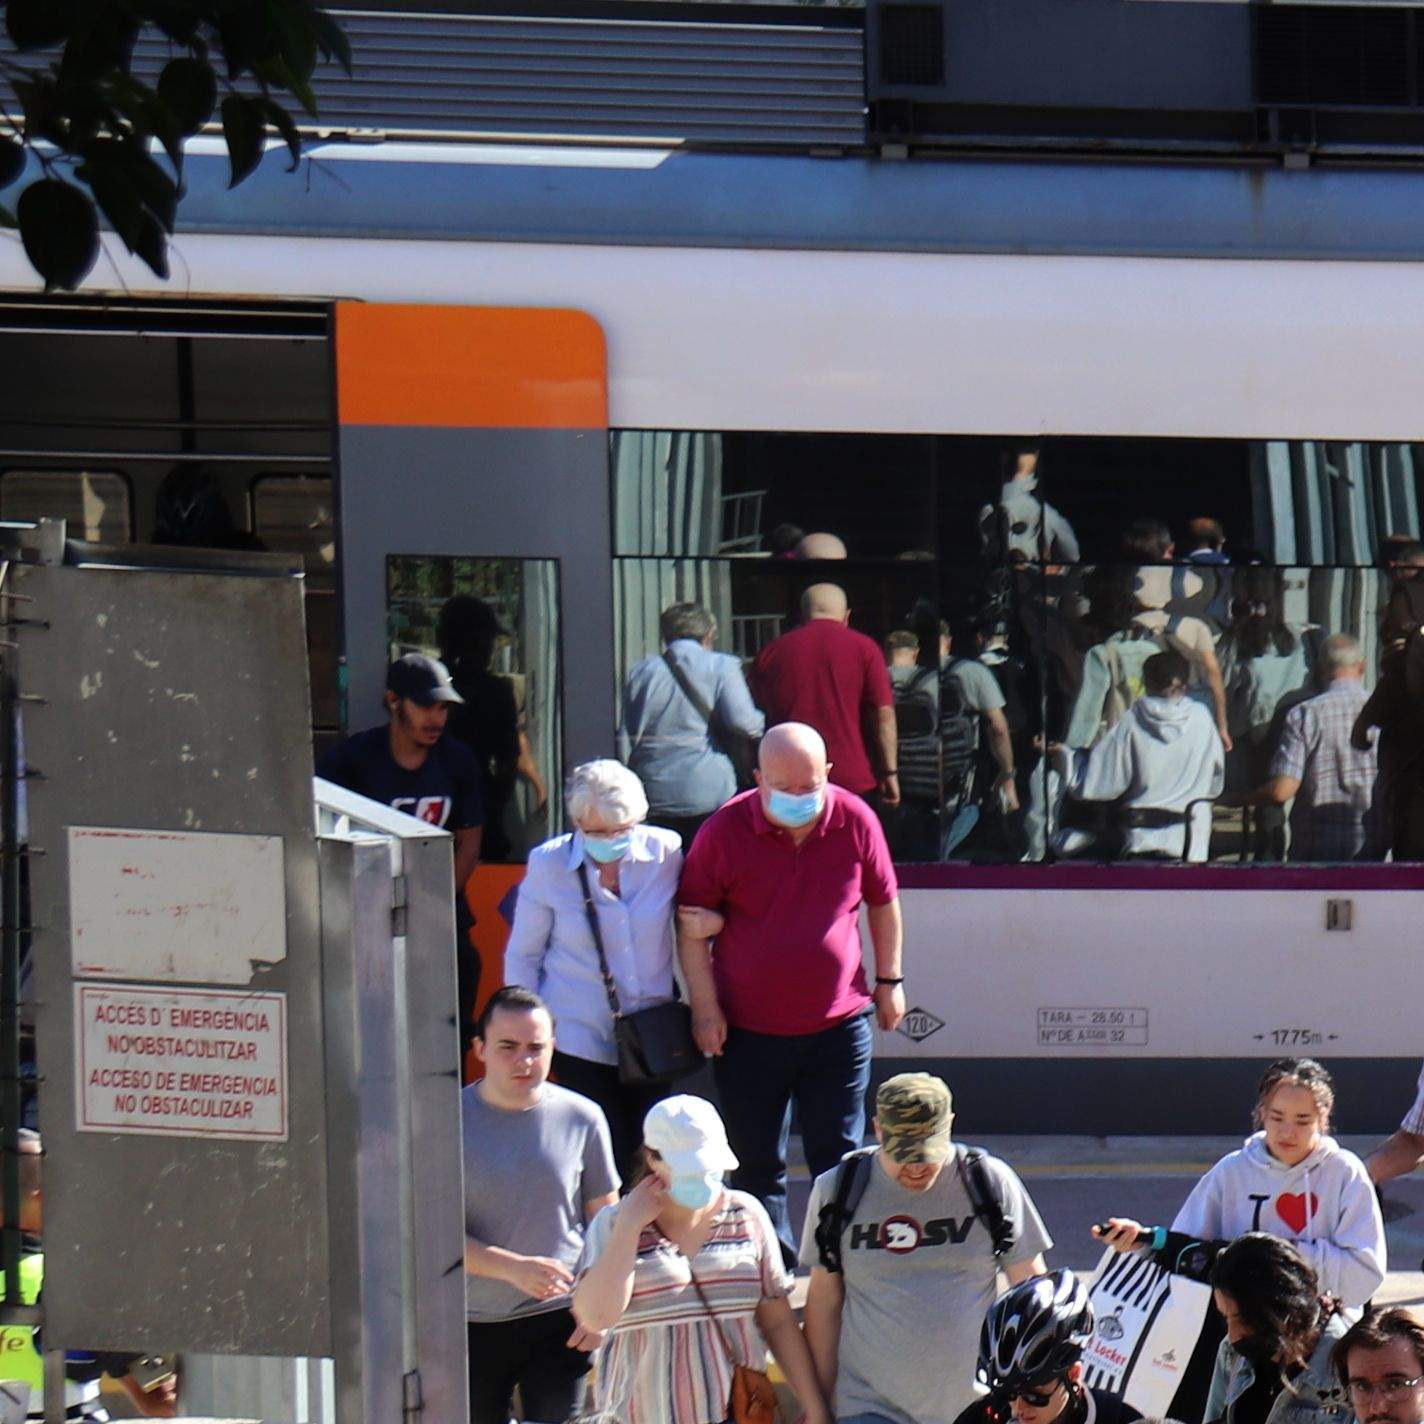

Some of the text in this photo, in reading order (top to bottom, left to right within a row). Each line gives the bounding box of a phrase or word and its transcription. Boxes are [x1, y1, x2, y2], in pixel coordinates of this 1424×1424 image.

[1041, 1010, 1073, 1023] TARA
[107, 1034, 258, 1061] NO OBSTACULITZAR
[89, 1069, 278, 1096] ACCESO DE EMERGENCIA
[114, 1094, 254, 1119] NO OBSTACULIZAR
